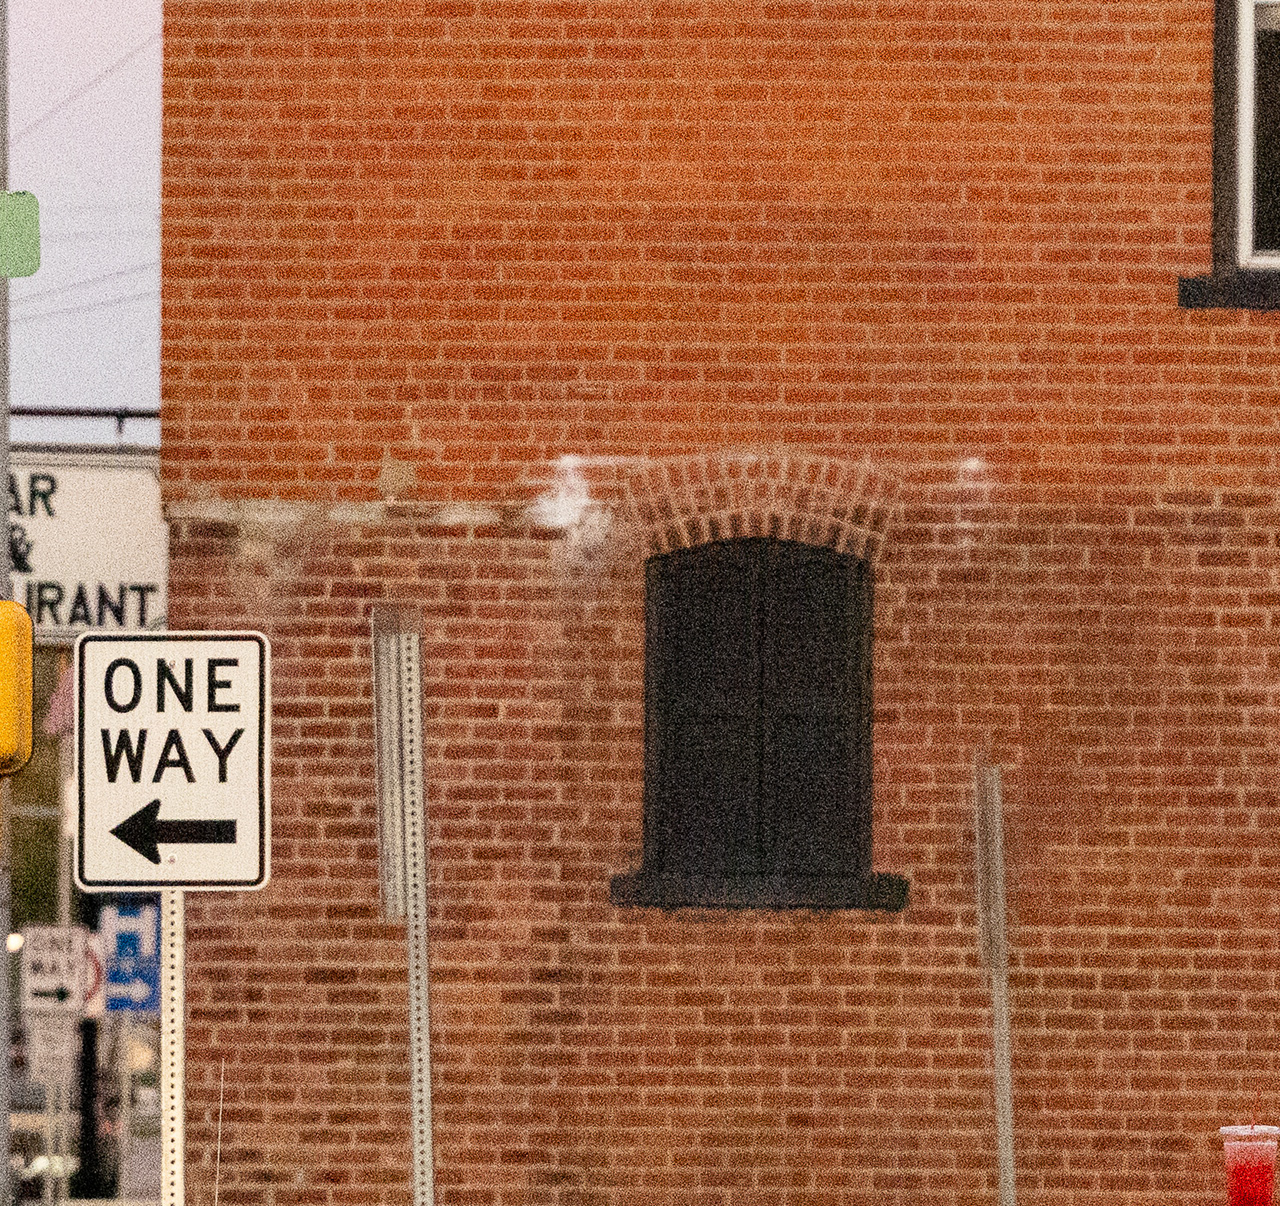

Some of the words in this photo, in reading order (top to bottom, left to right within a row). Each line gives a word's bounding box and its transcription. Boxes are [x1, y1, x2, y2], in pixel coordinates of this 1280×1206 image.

[8, 473, 58, 518] AR
[103, 657, 241, 714] ONE
[100, 727, 246, 784] WAY
